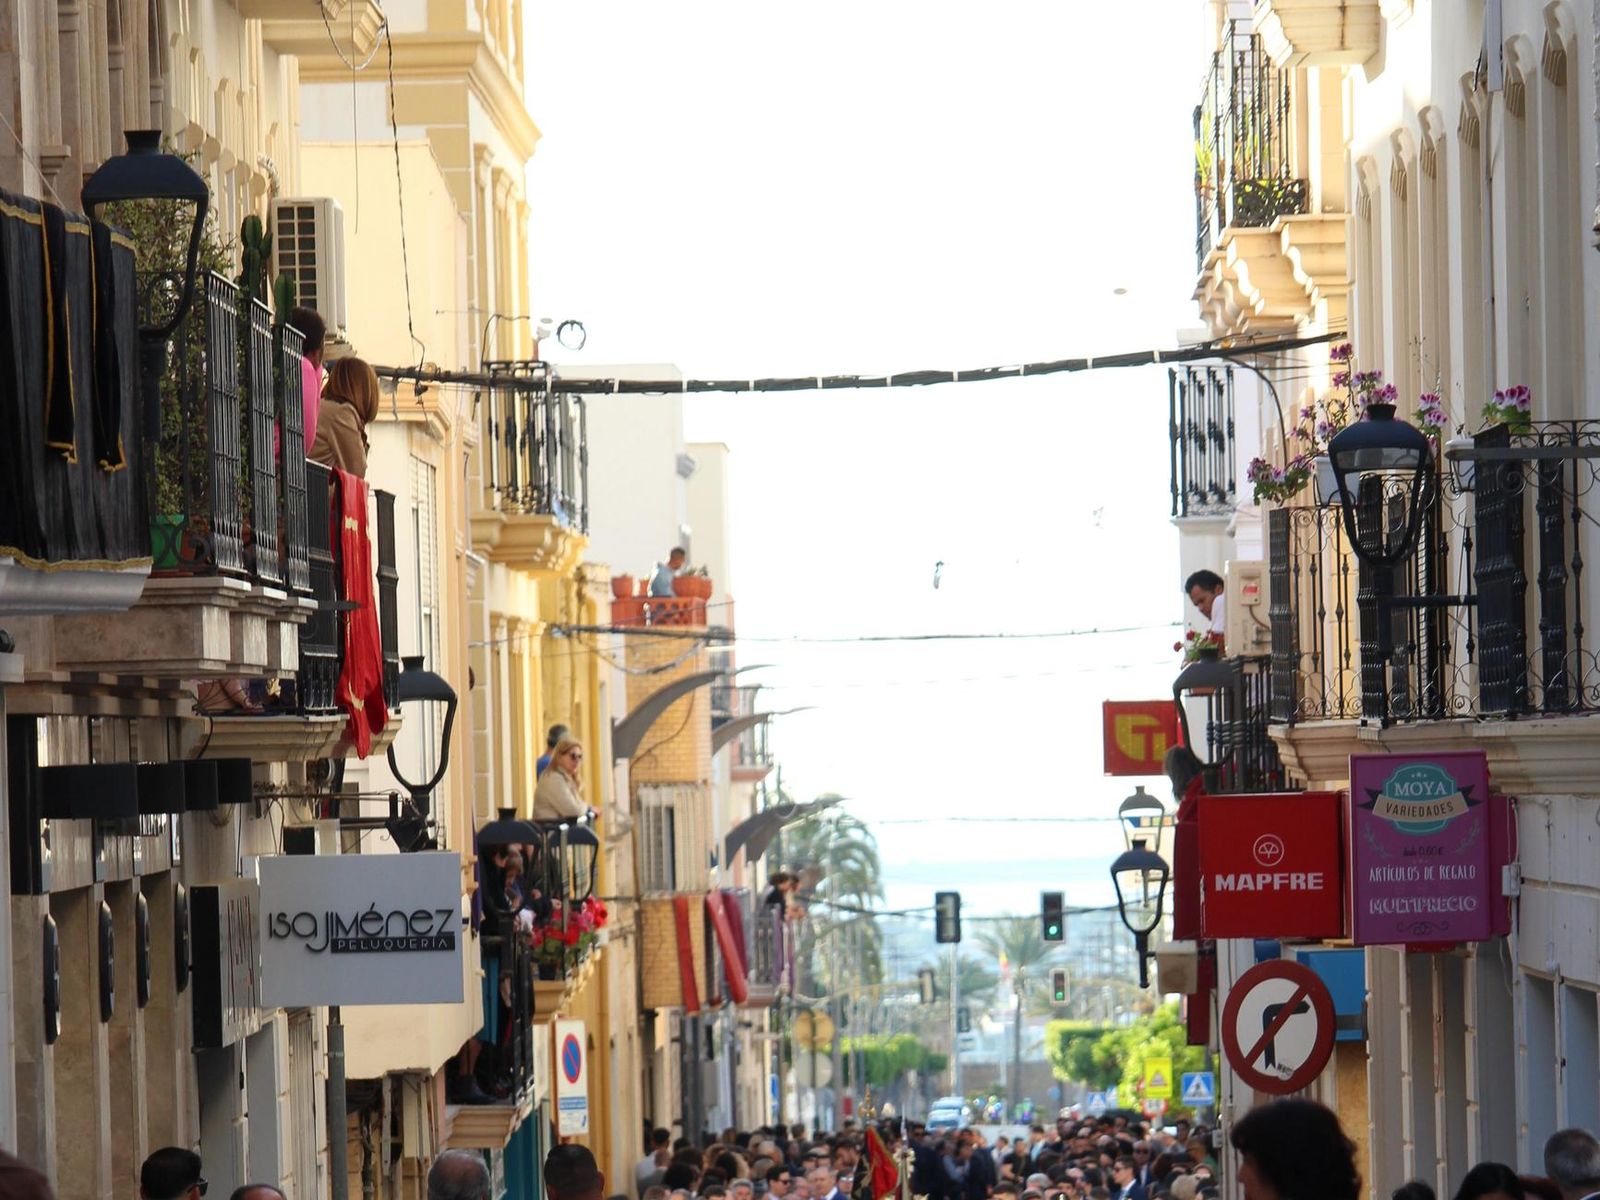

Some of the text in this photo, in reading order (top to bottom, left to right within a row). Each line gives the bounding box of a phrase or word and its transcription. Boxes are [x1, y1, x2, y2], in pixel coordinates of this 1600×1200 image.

[1394, 781, 1447, 797] MOYA
[1385, 801, 1454, 818] VARIEDADES
[1424, 866, 1435, 880] DE
[1439, 864, 1476, 881] REGALO
[1215, 872, 1324, 892] MAPFRE
[1369, 895, 1477, 915] MULTIPRECIO
